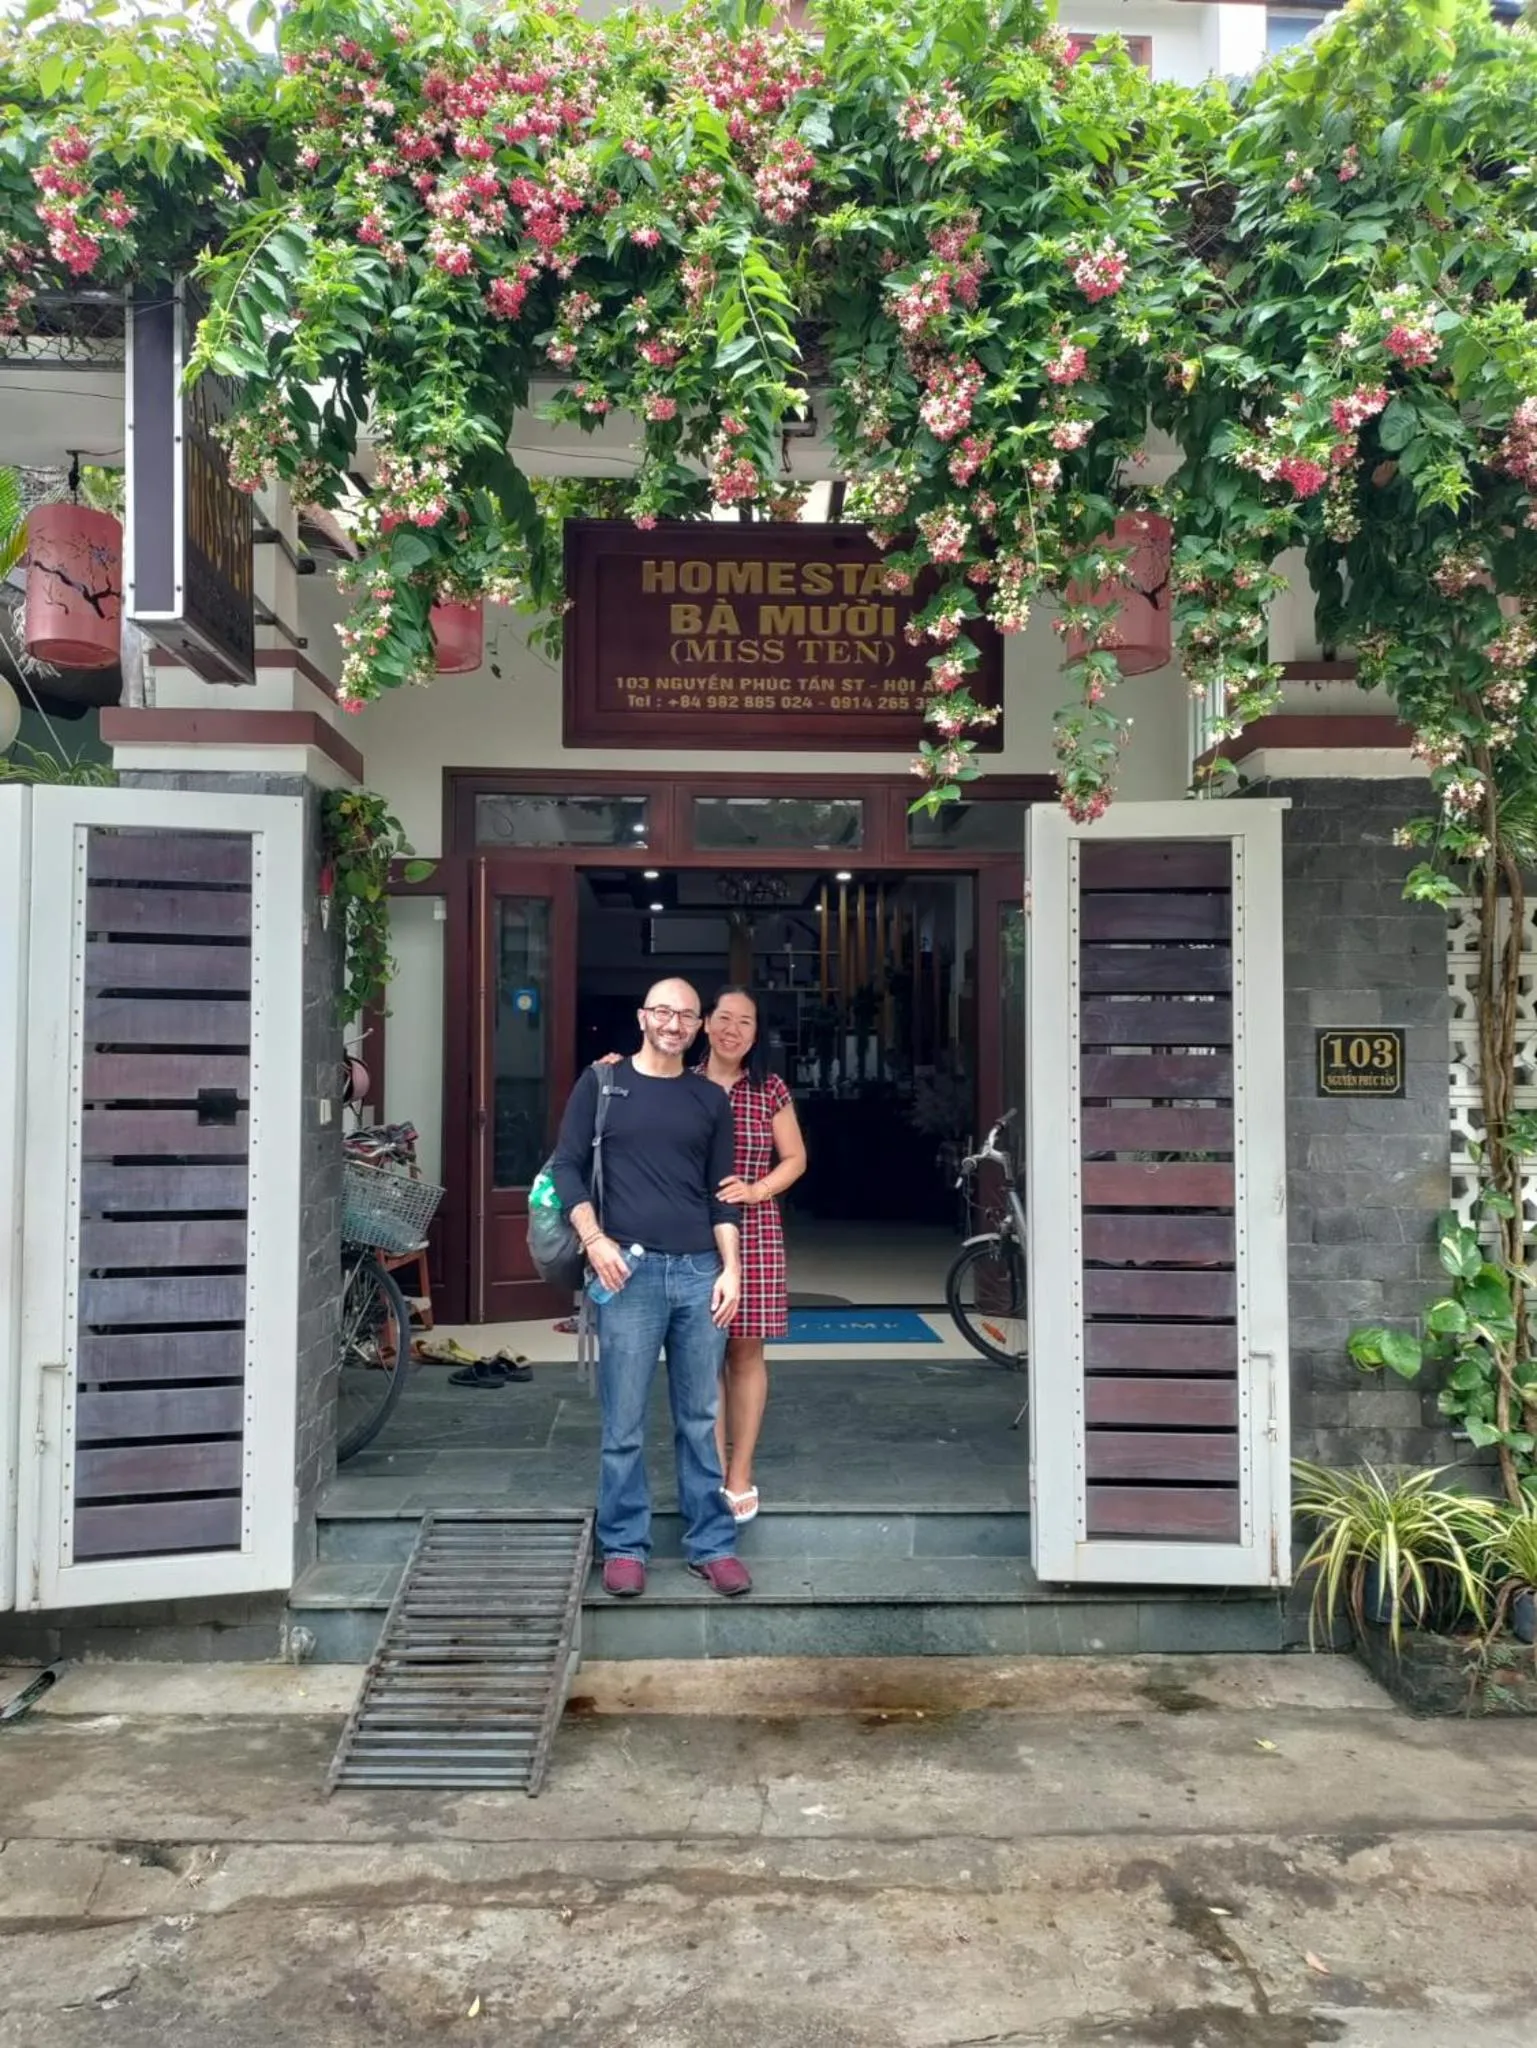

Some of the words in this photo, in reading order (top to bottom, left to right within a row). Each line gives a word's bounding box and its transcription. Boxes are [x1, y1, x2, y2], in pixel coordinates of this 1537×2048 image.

[670, 598, 741, 636] BÀ
[759, 598, 896, 637] MƯỜI
[670, 639, 785, 665] (MISS
[797, 640, 896, 667] TEN)
[616, 676, 649, 689] 103
[842, 678, 865, 692] ST
[884, 677, 916, 696] HỘI
[627, 694, 651, 708] Tel
[667, 695, 701, 708] +84
[782, 696, 812, 709] 024
[830, 696, 872, 710] 0914
[877, 696, 909, 710] 265
[1329, 1038, 1393, 1068] 103
